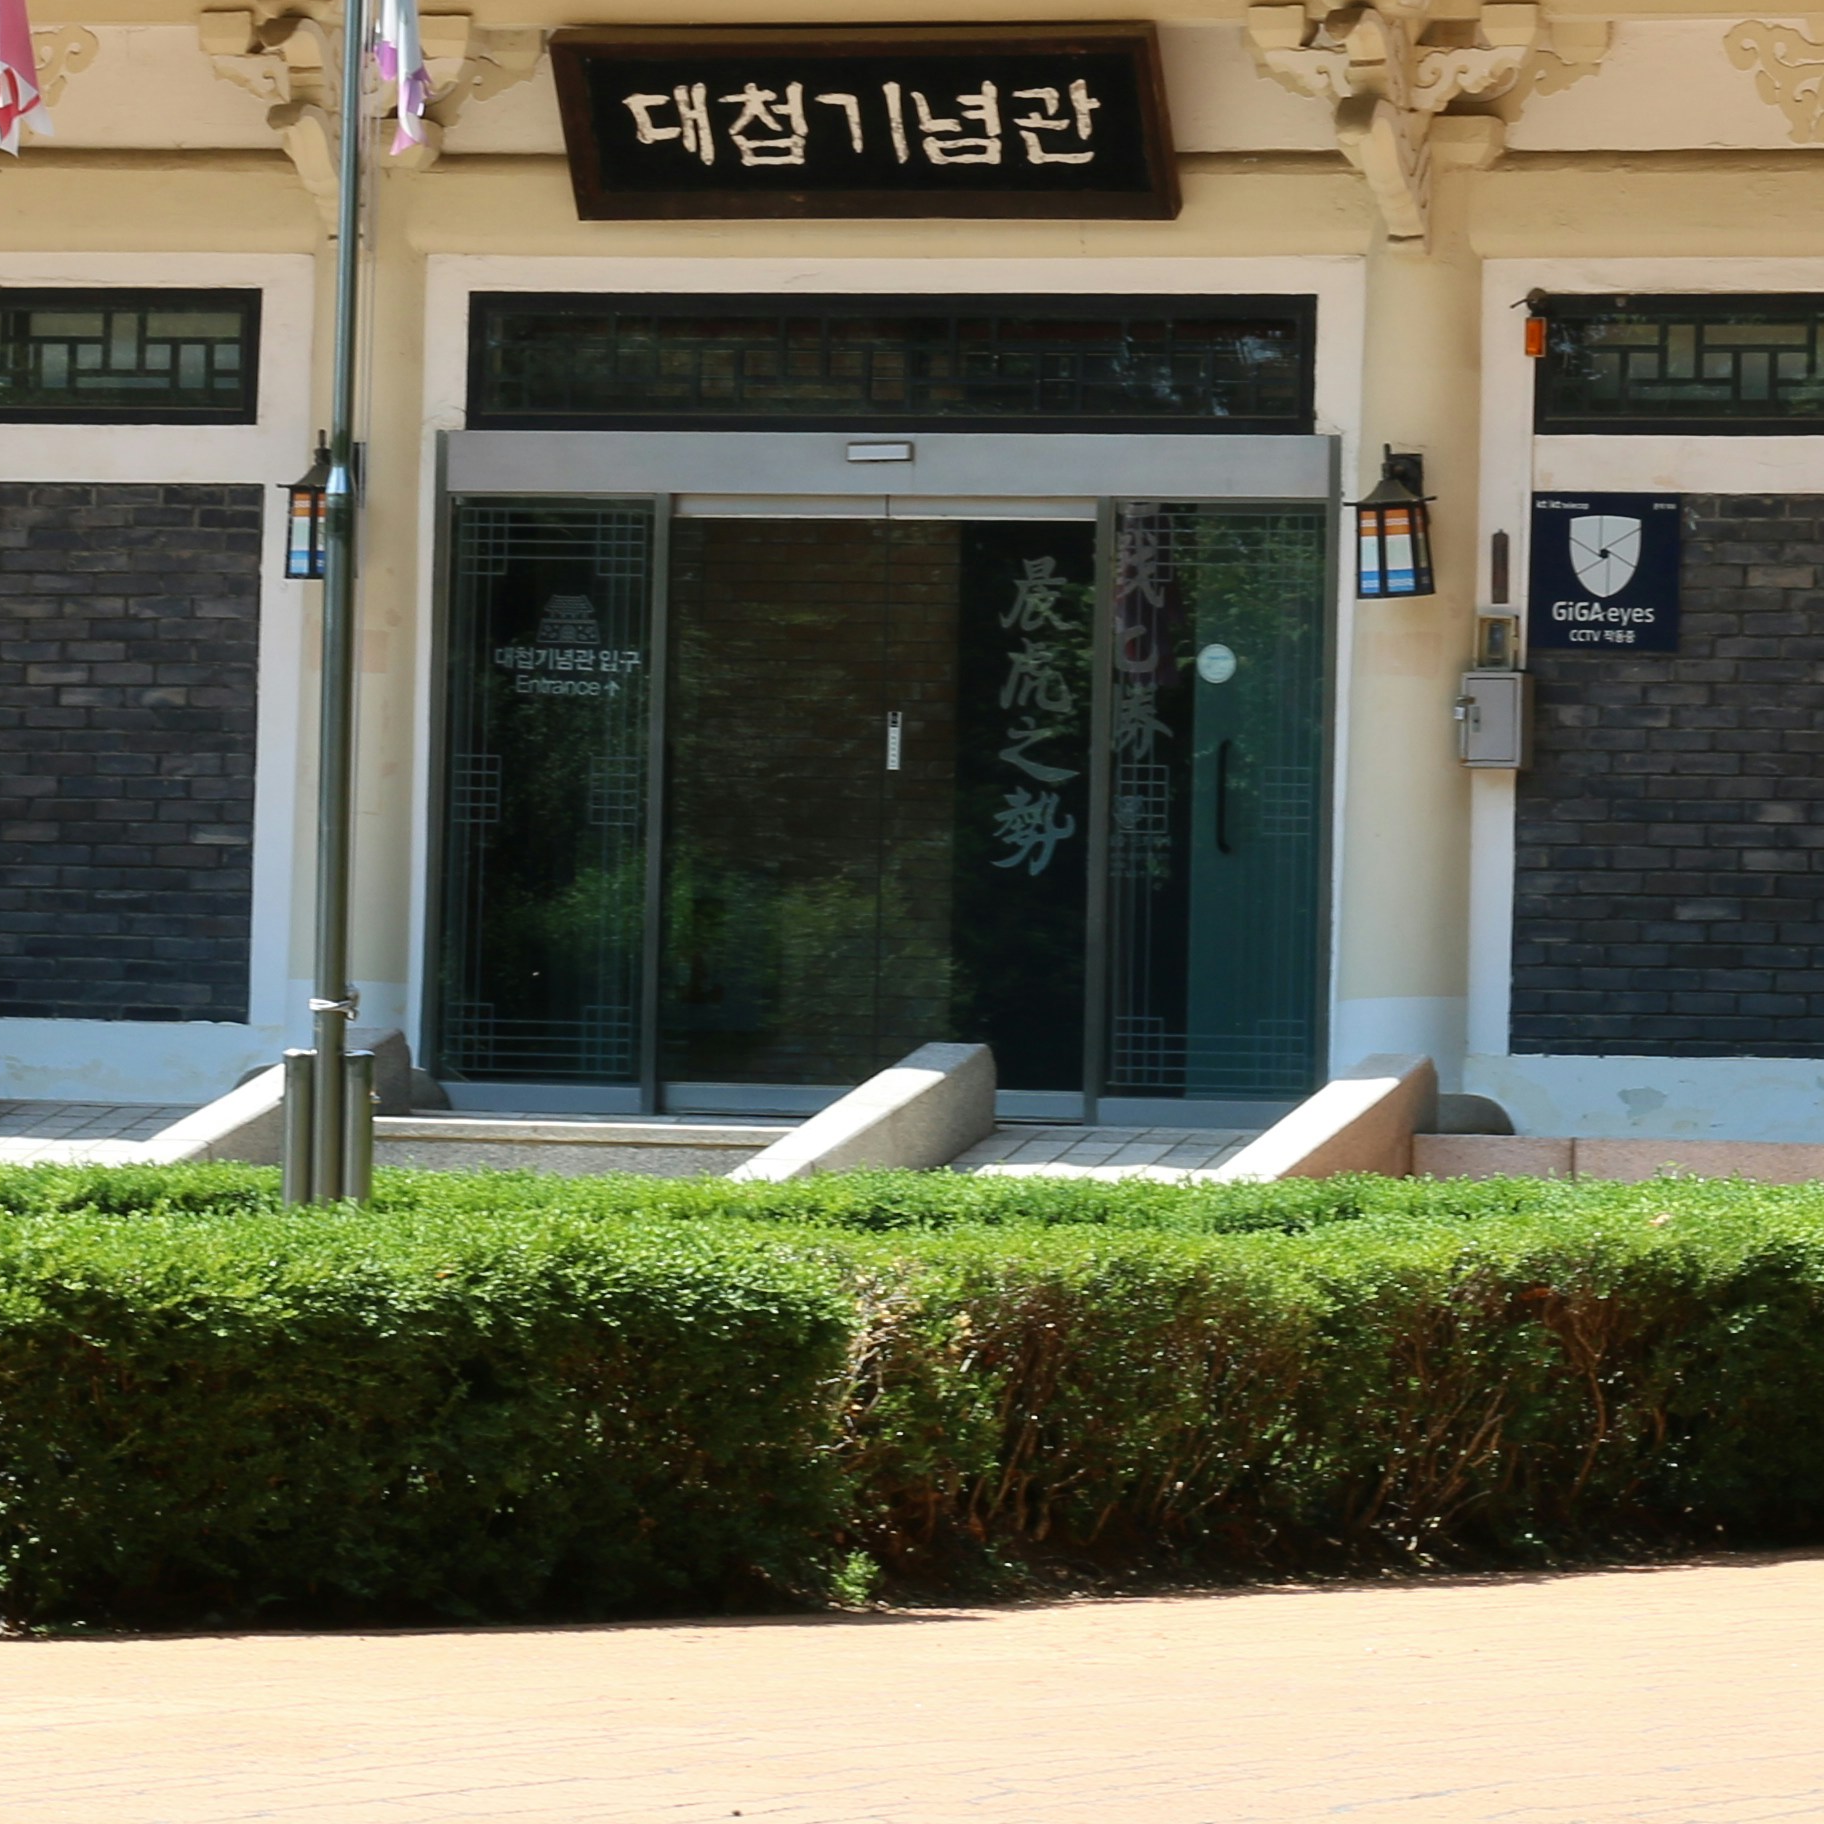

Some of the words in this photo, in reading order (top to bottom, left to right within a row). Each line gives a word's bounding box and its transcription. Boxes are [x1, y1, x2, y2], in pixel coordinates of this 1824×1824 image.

[623, 79, 1101, 166] 대첩기념관
[1569, 629, 1601, 642] CCTV
[494, 647, 597, 671] 대첩기념관
[599, 649, 642, 673] 입구
[515, 675, 601, 696] Entrance
